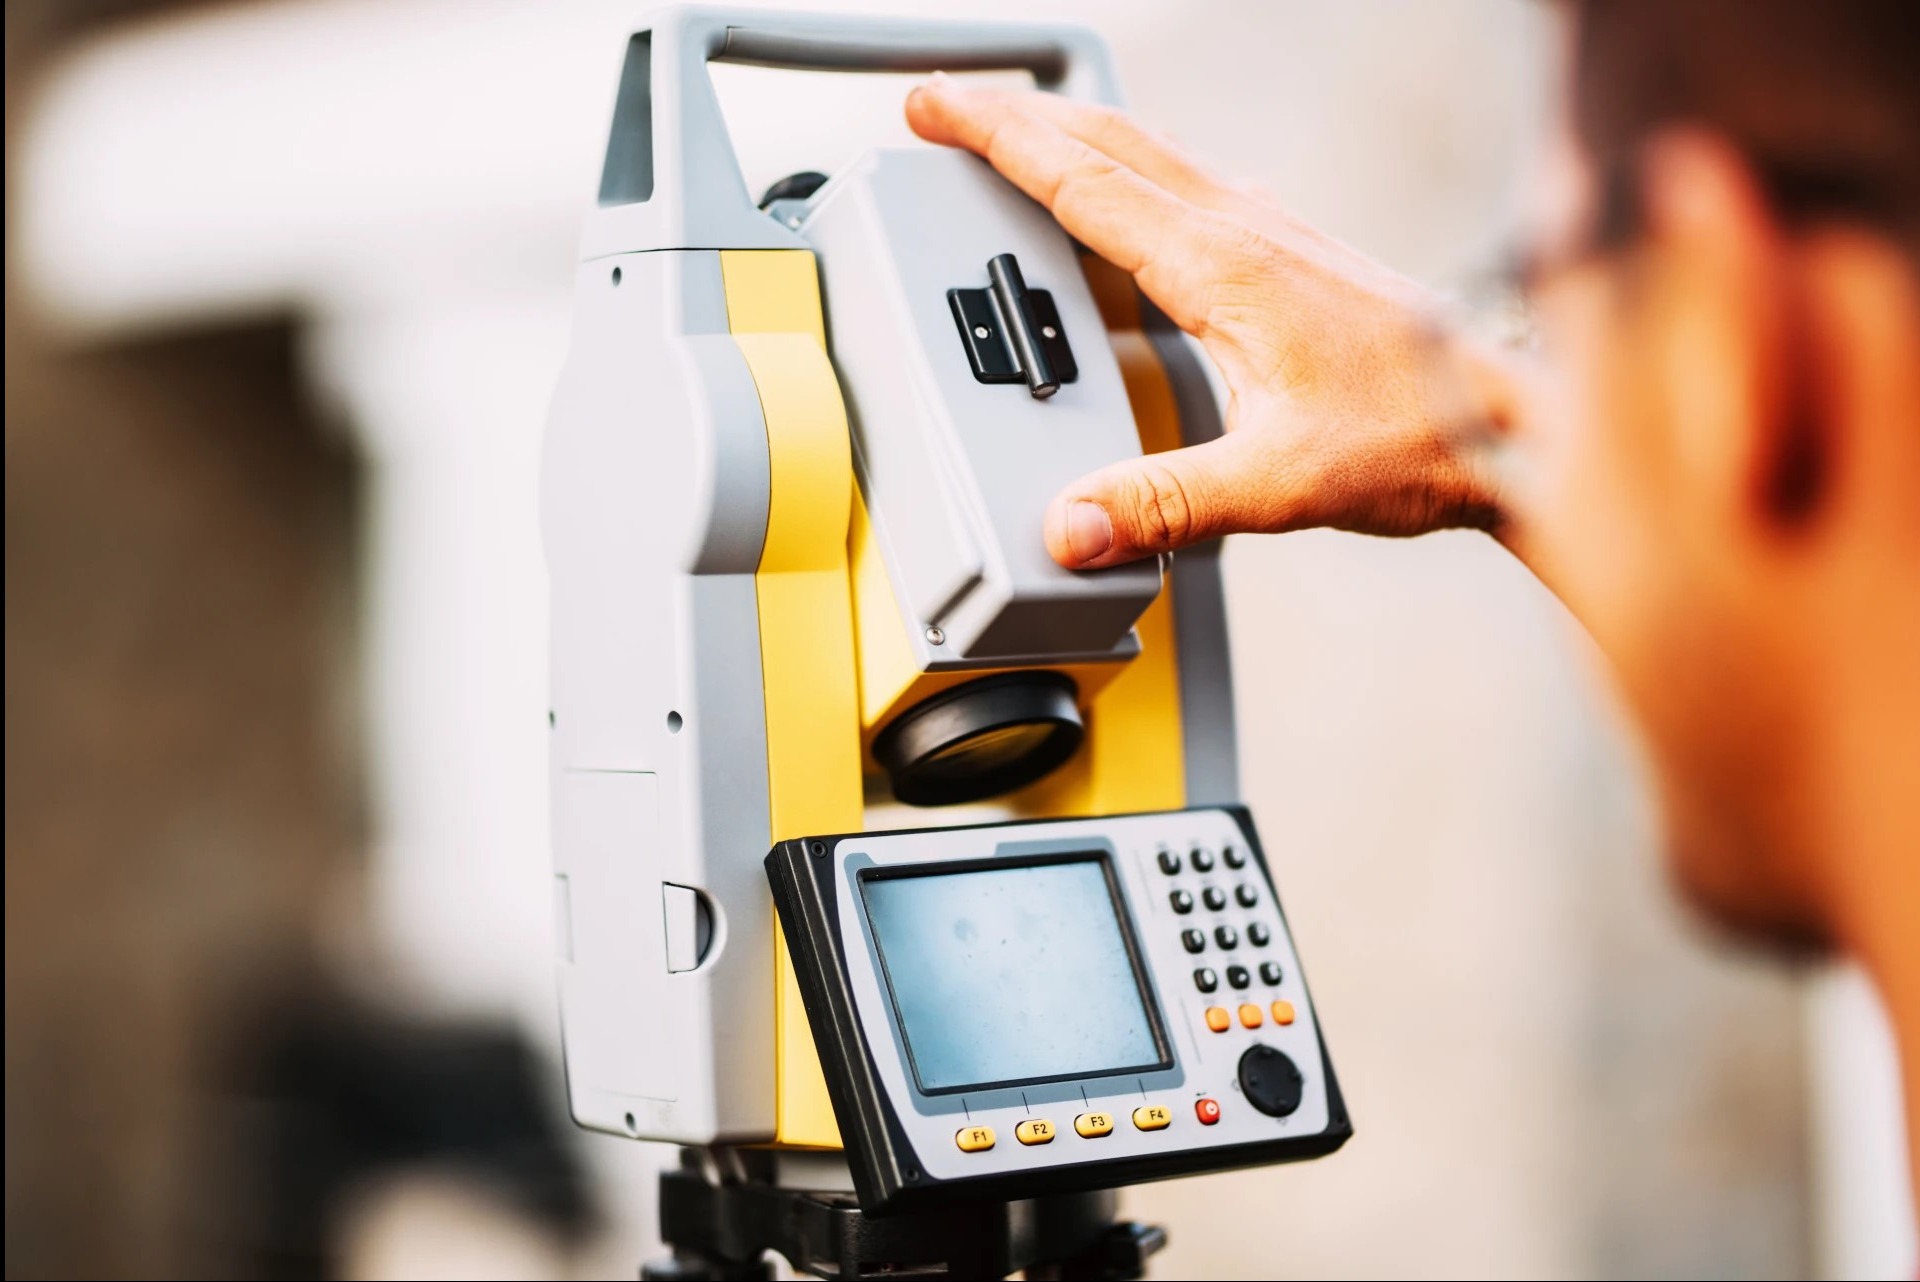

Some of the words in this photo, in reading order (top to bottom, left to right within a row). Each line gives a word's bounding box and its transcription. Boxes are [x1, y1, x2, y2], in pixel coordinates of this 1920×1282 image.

[1090, 1115, 1105, 1127] F3
[1149, 1109, 1164, 1121] F4
[1033, 1123, 1048, 1135] F2
[973, 1131, 987, 1143] F1
